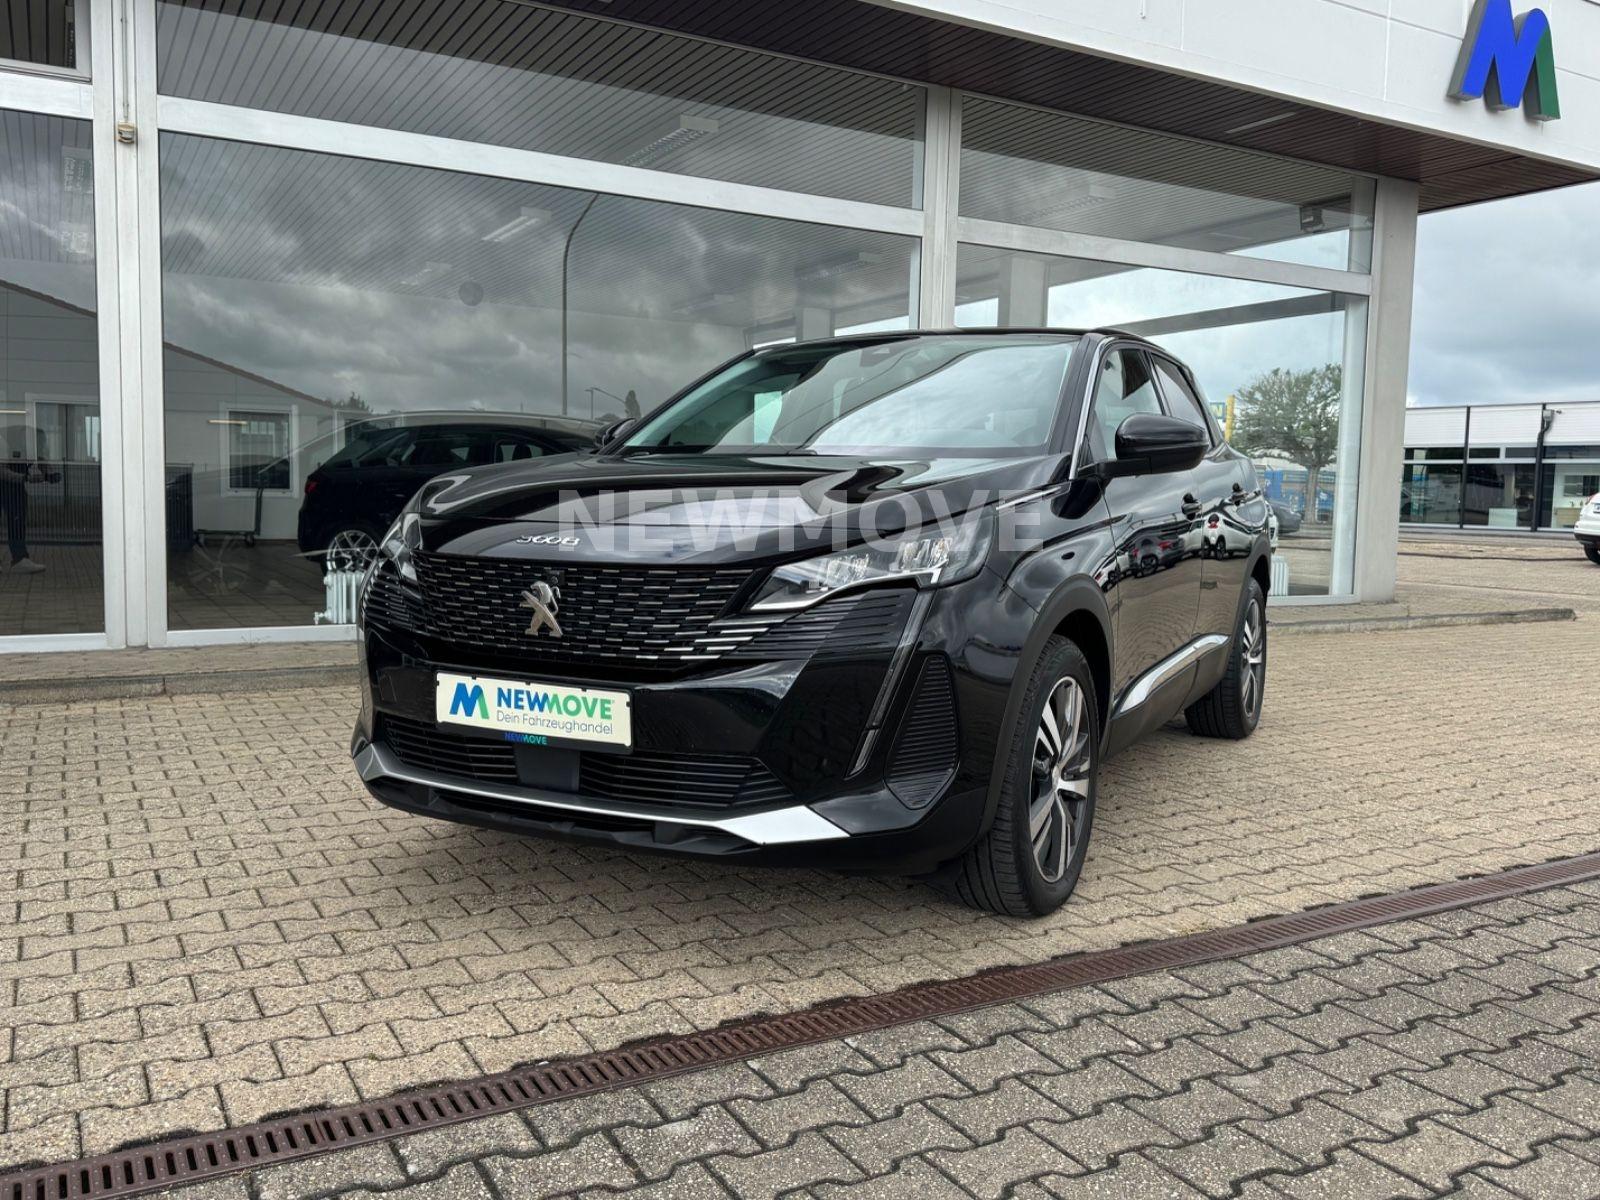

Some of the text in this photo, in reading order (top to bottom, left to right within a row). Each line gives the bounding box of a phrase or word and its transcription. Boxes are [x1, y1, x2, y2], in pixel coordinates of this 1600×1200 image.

[497, 687, 613, 720] NEWMOVE
[497, 710, 613, 734] Dein Fahrzeughandel
[504, 731, 548, 745] NEWMOVE
